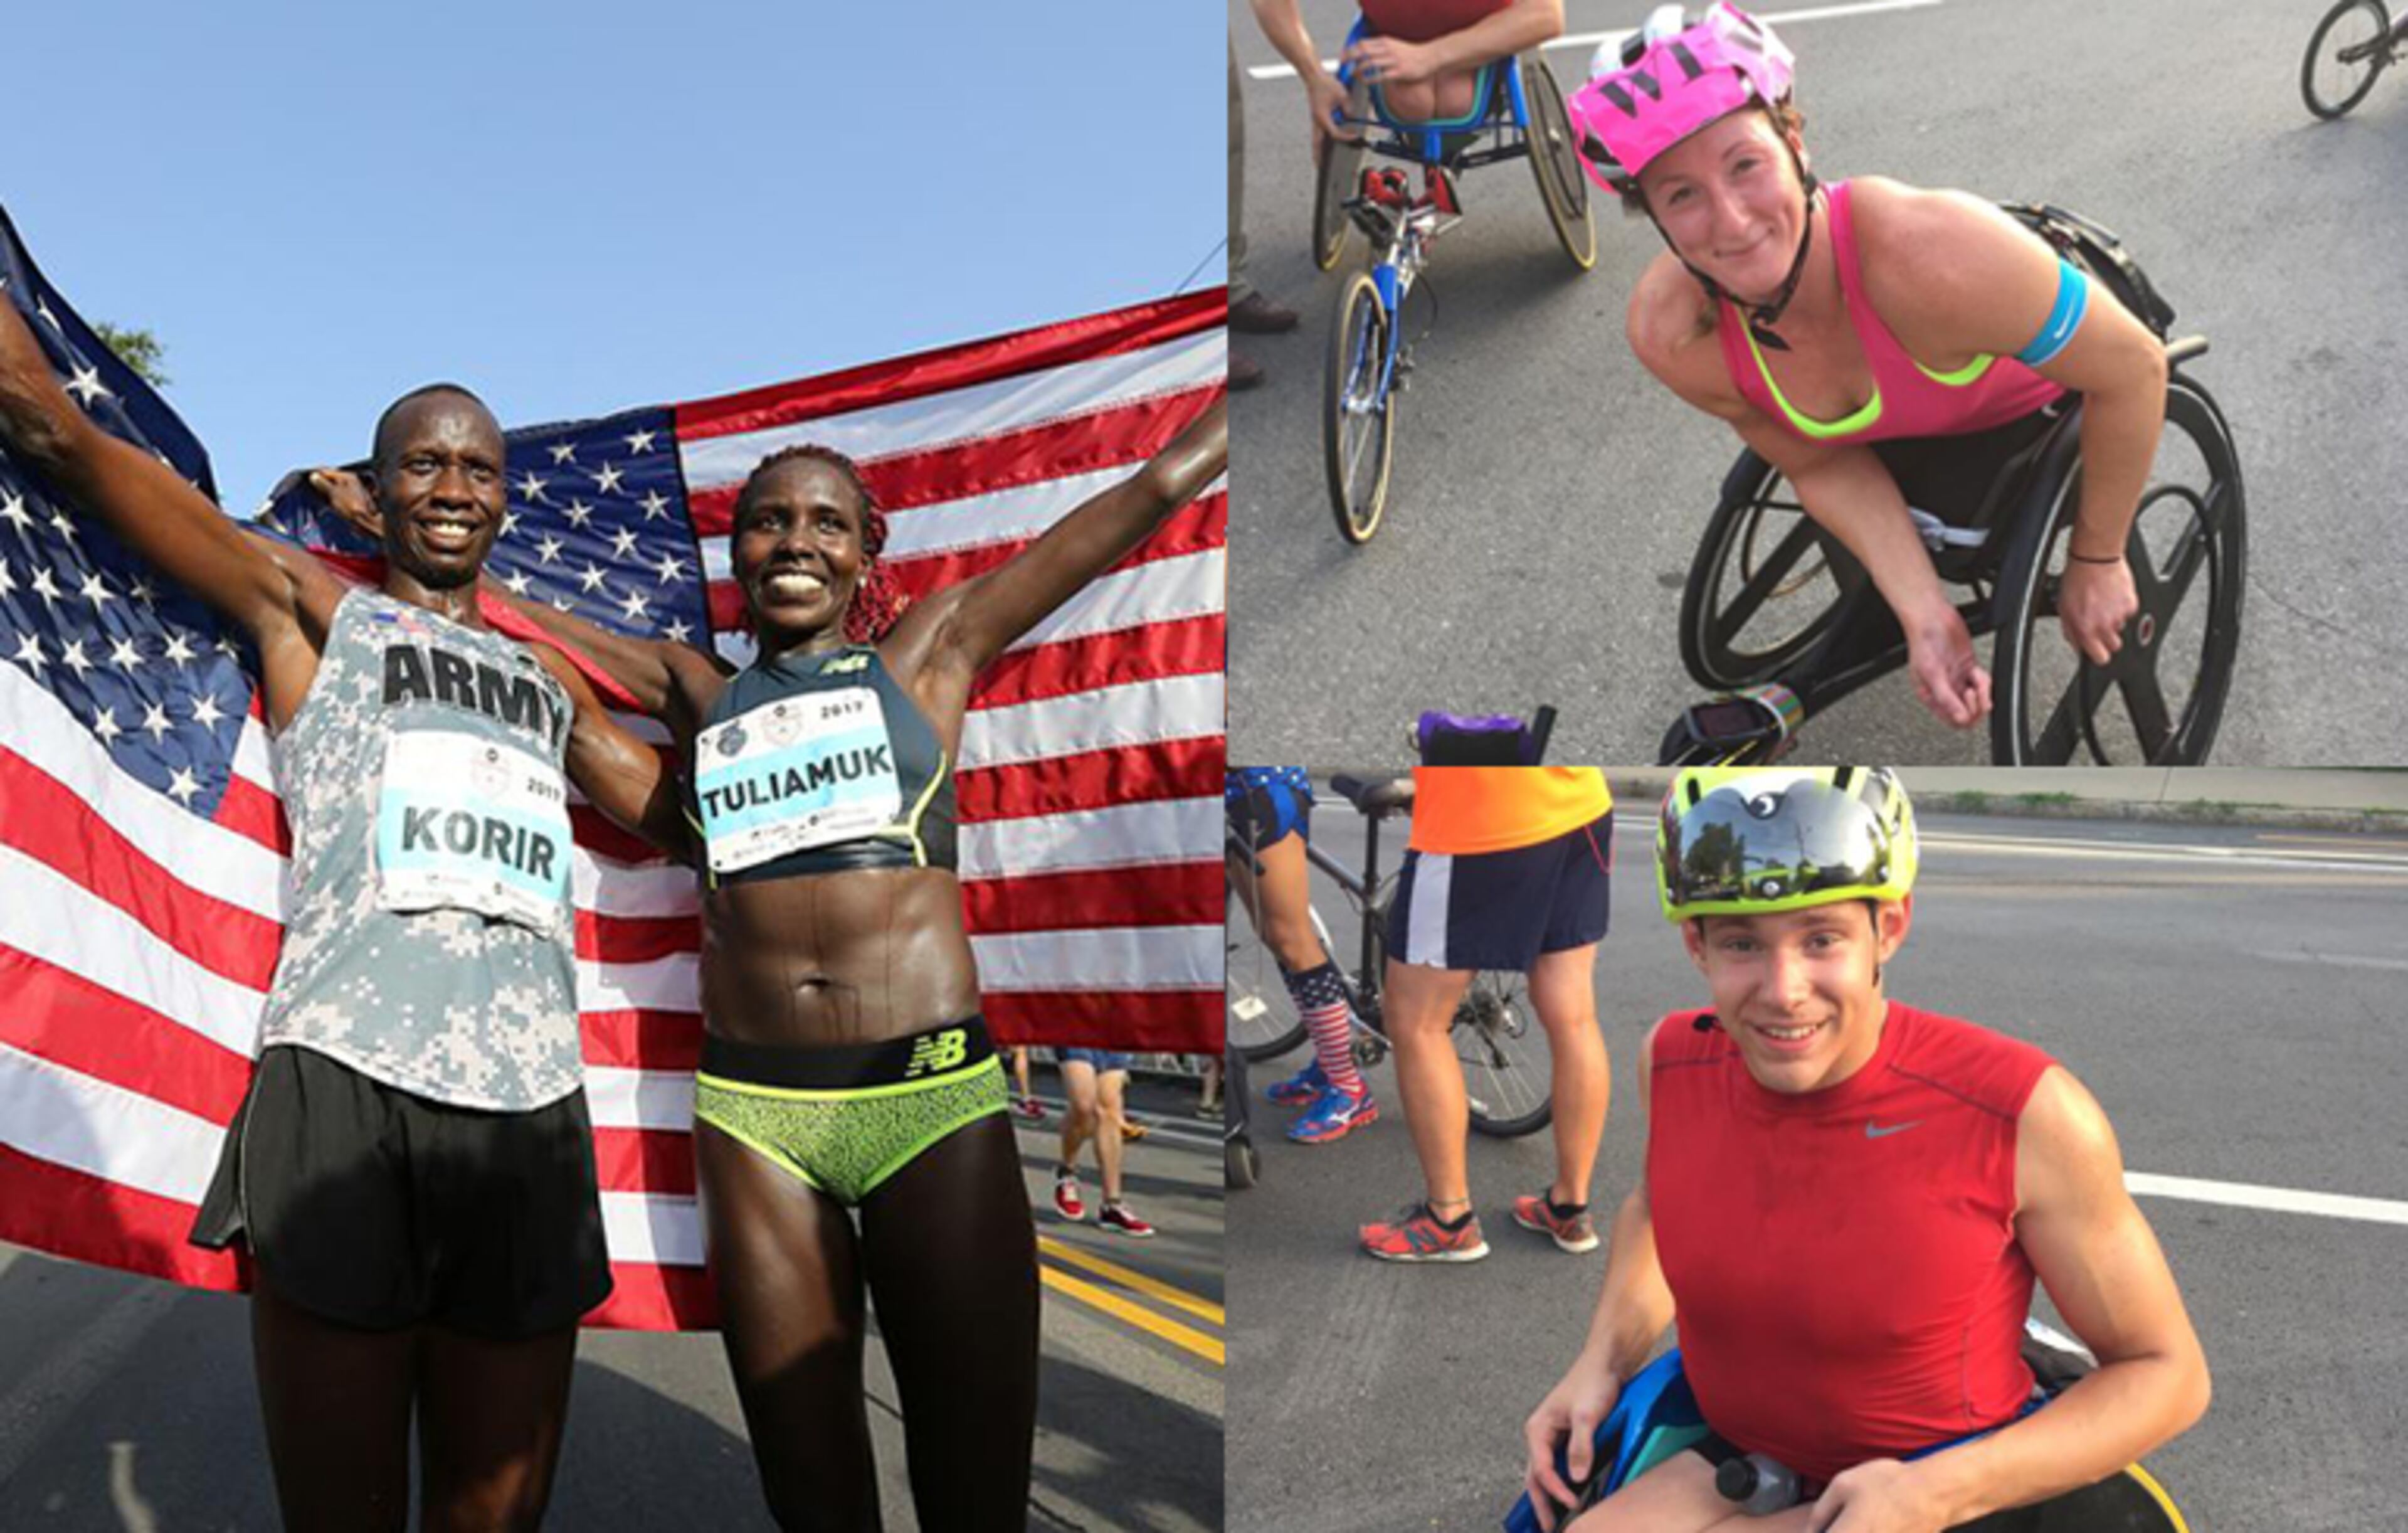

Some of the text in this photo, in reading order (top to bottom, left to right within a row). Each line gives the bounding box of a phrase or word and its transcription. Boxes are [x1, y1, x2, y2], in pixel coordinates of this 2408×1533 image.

[382, 644, 564, 749] ARMY
[821, 701, 863, 719] 2017
[701, 743, 892, 818] TULIAMUK
[401, 805, 556, 882] KORIR
